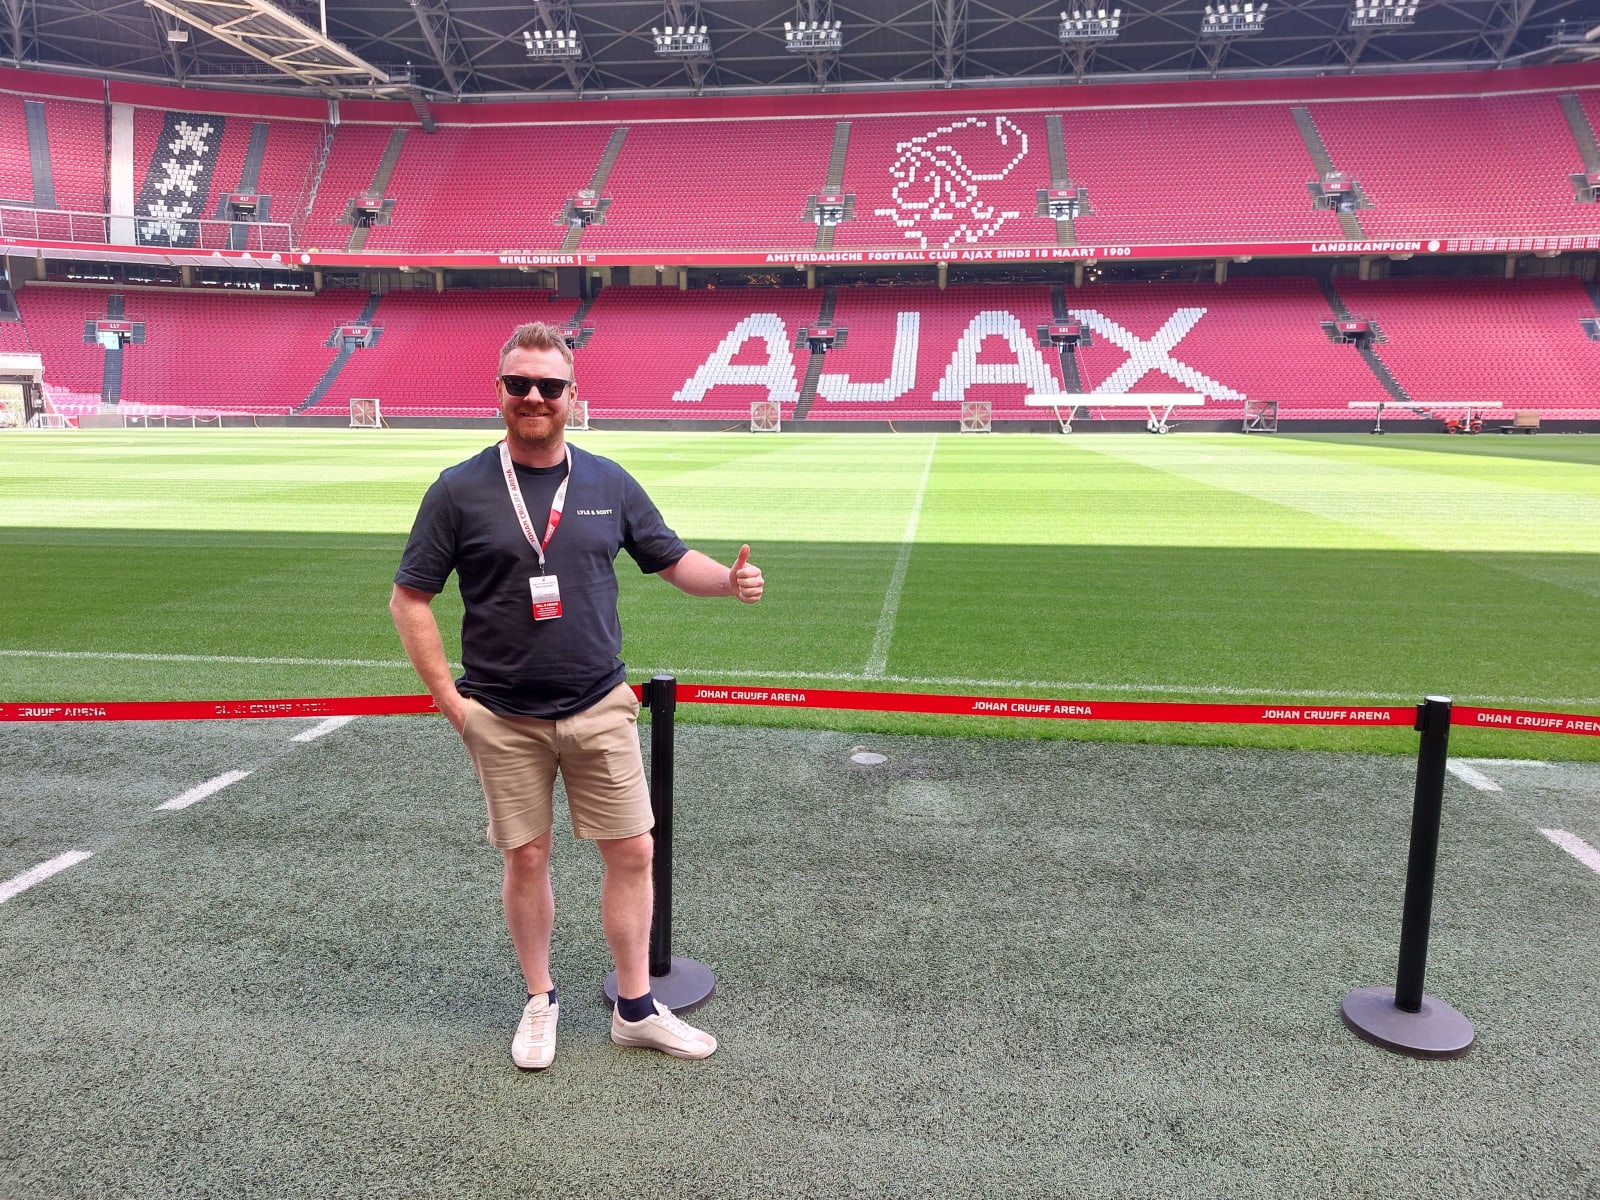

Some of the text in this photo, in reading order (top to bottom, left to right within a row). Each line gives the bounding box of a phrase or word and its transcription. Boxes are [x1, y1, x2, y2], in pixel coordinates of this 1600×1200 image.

[1311, 240, 1421, 253] LANDSKAMPIOEN
[498, 255, 574, 264] WERELDBEKER
[765, 247, 1132, 263] AMSTERDAMSCHE FOOTBALL CLUB AJAX SINDS 18 MAART 1900
[672, 307, 1247, 402] AJAX
[694, 689, 729, 700] JOHAN
[770, 692, 806, 702] ARENA
[971, 701, 1008, 712] JOHAN
[1053, 705, 1092, 715] ARENA
[1261, 709, 1300, 720] JOHAN
[1349, 711, 1391, 720] ARENA
[1477, 712, 1512, 724] OHAN
[1565, 720, 1600, 731] AREN
